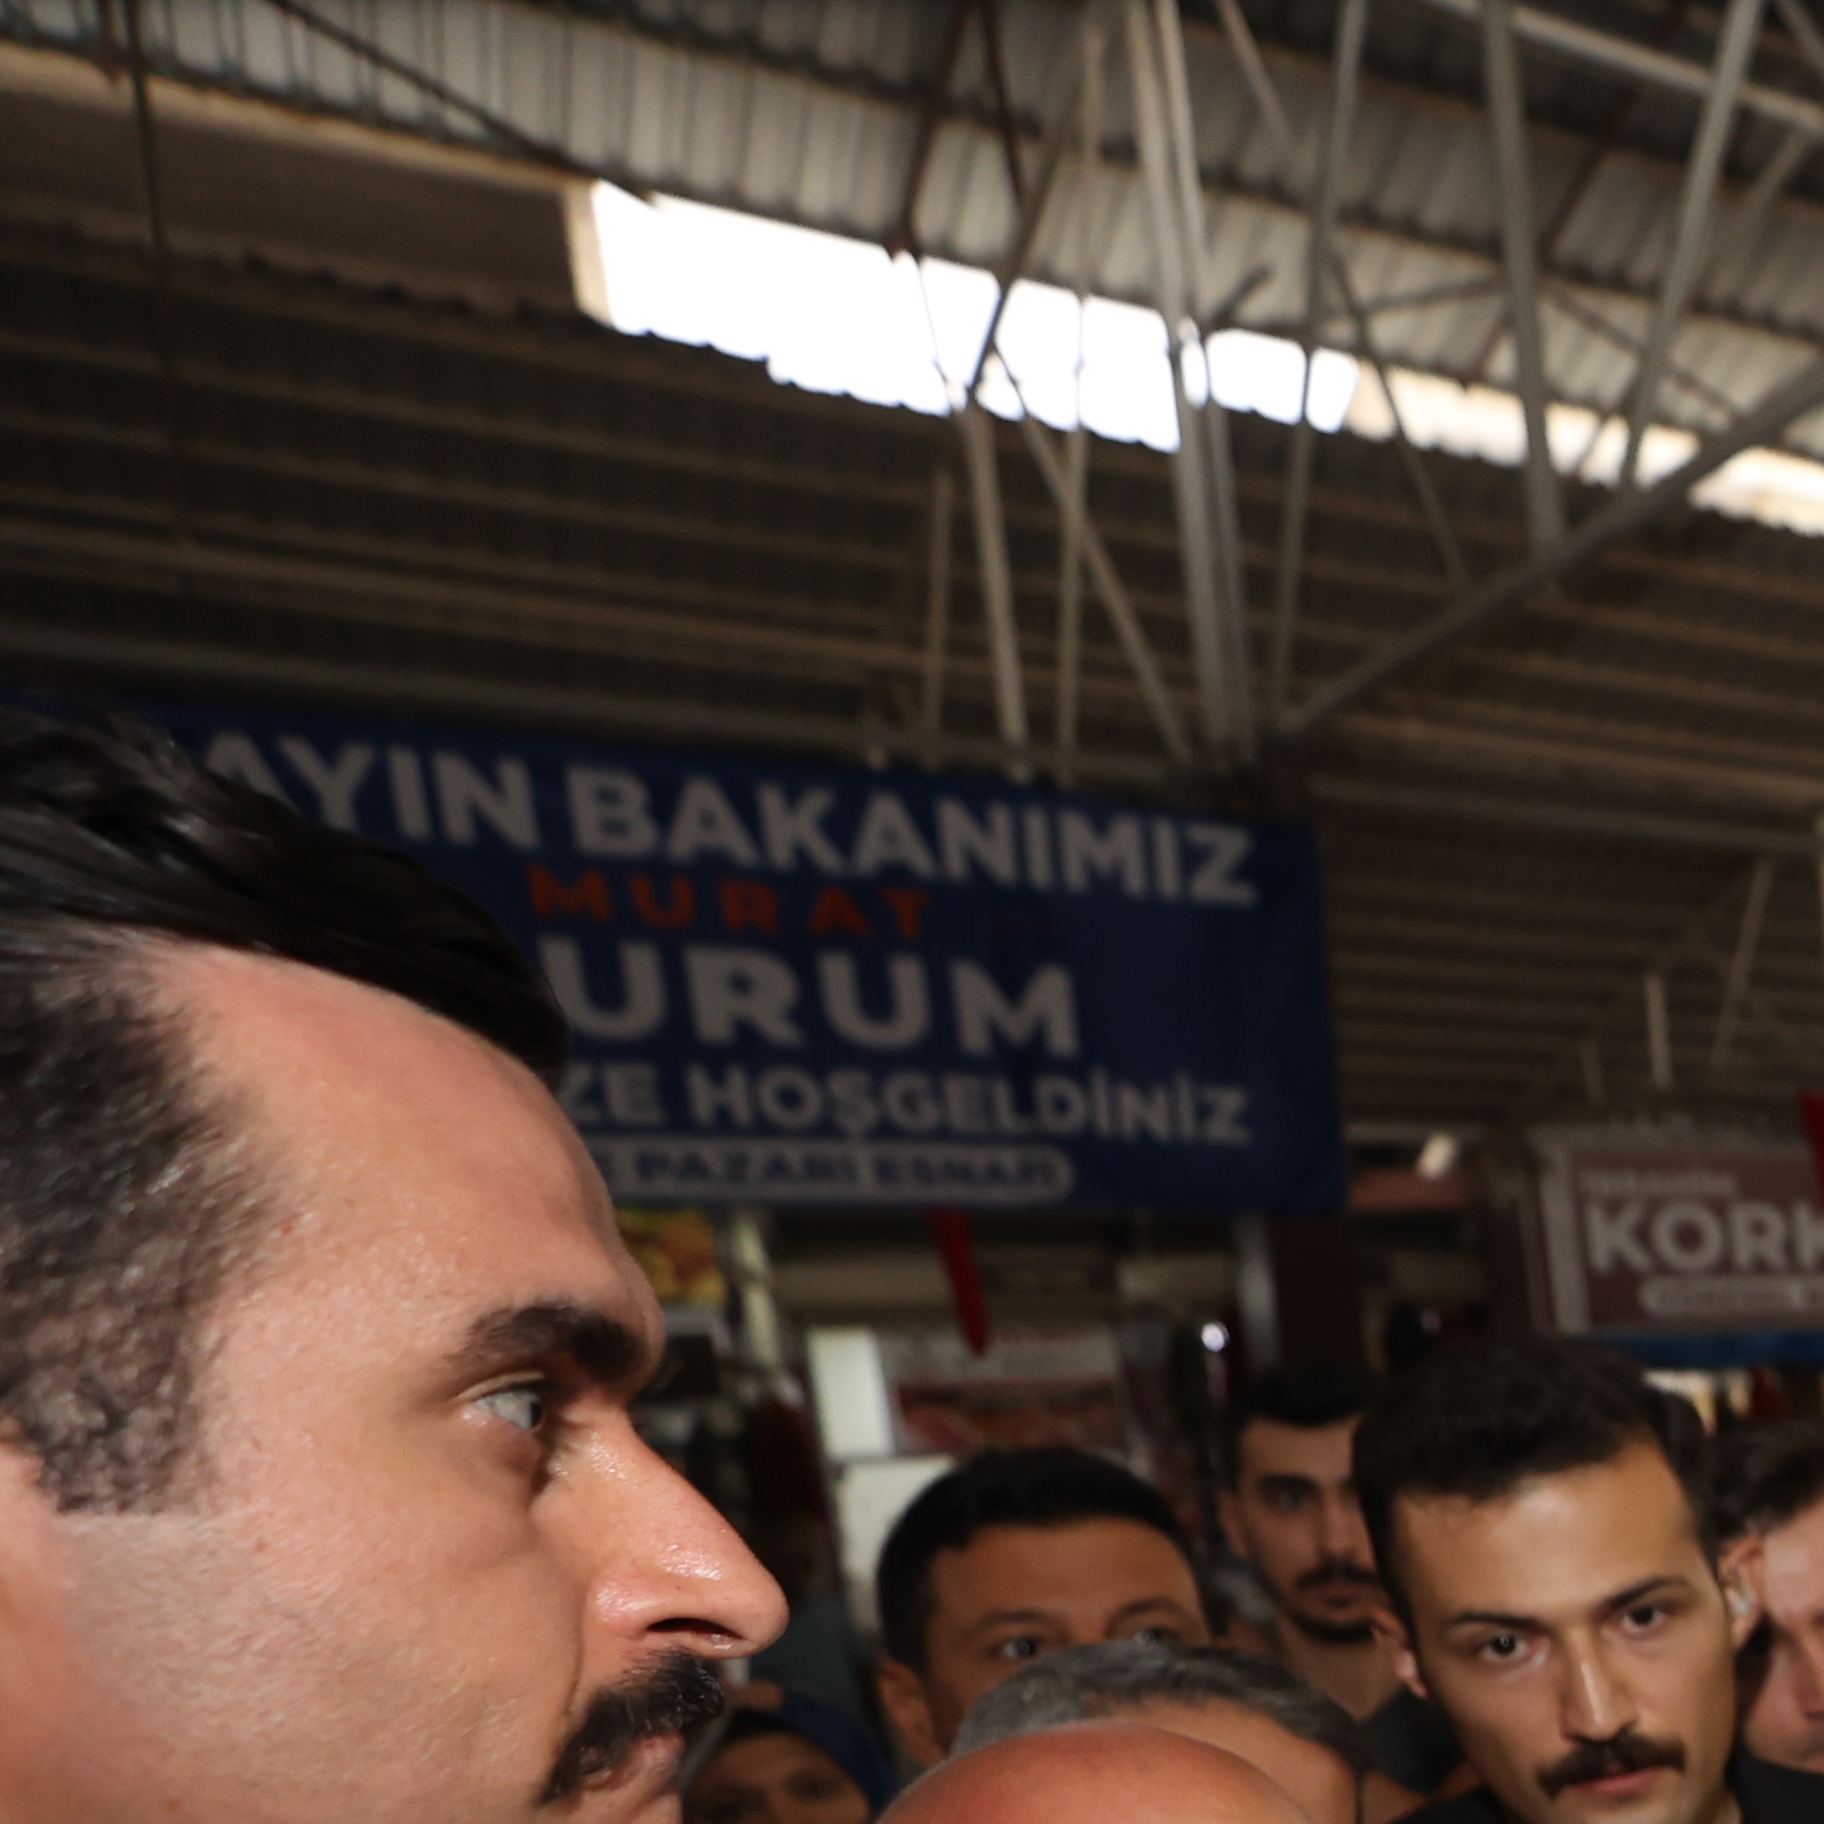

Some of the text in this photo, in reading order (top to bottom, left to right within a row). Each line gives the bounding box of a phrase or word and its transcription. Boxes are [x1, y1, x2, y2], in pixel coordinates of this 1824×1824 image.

[201, 729, 1257, 905] AYIN BAKANIMIZ
[528, 863, 932, 940] MURAT
[537, 933, 1080, 1056] URUM
[557, 1059, 667, 1126] ZE
